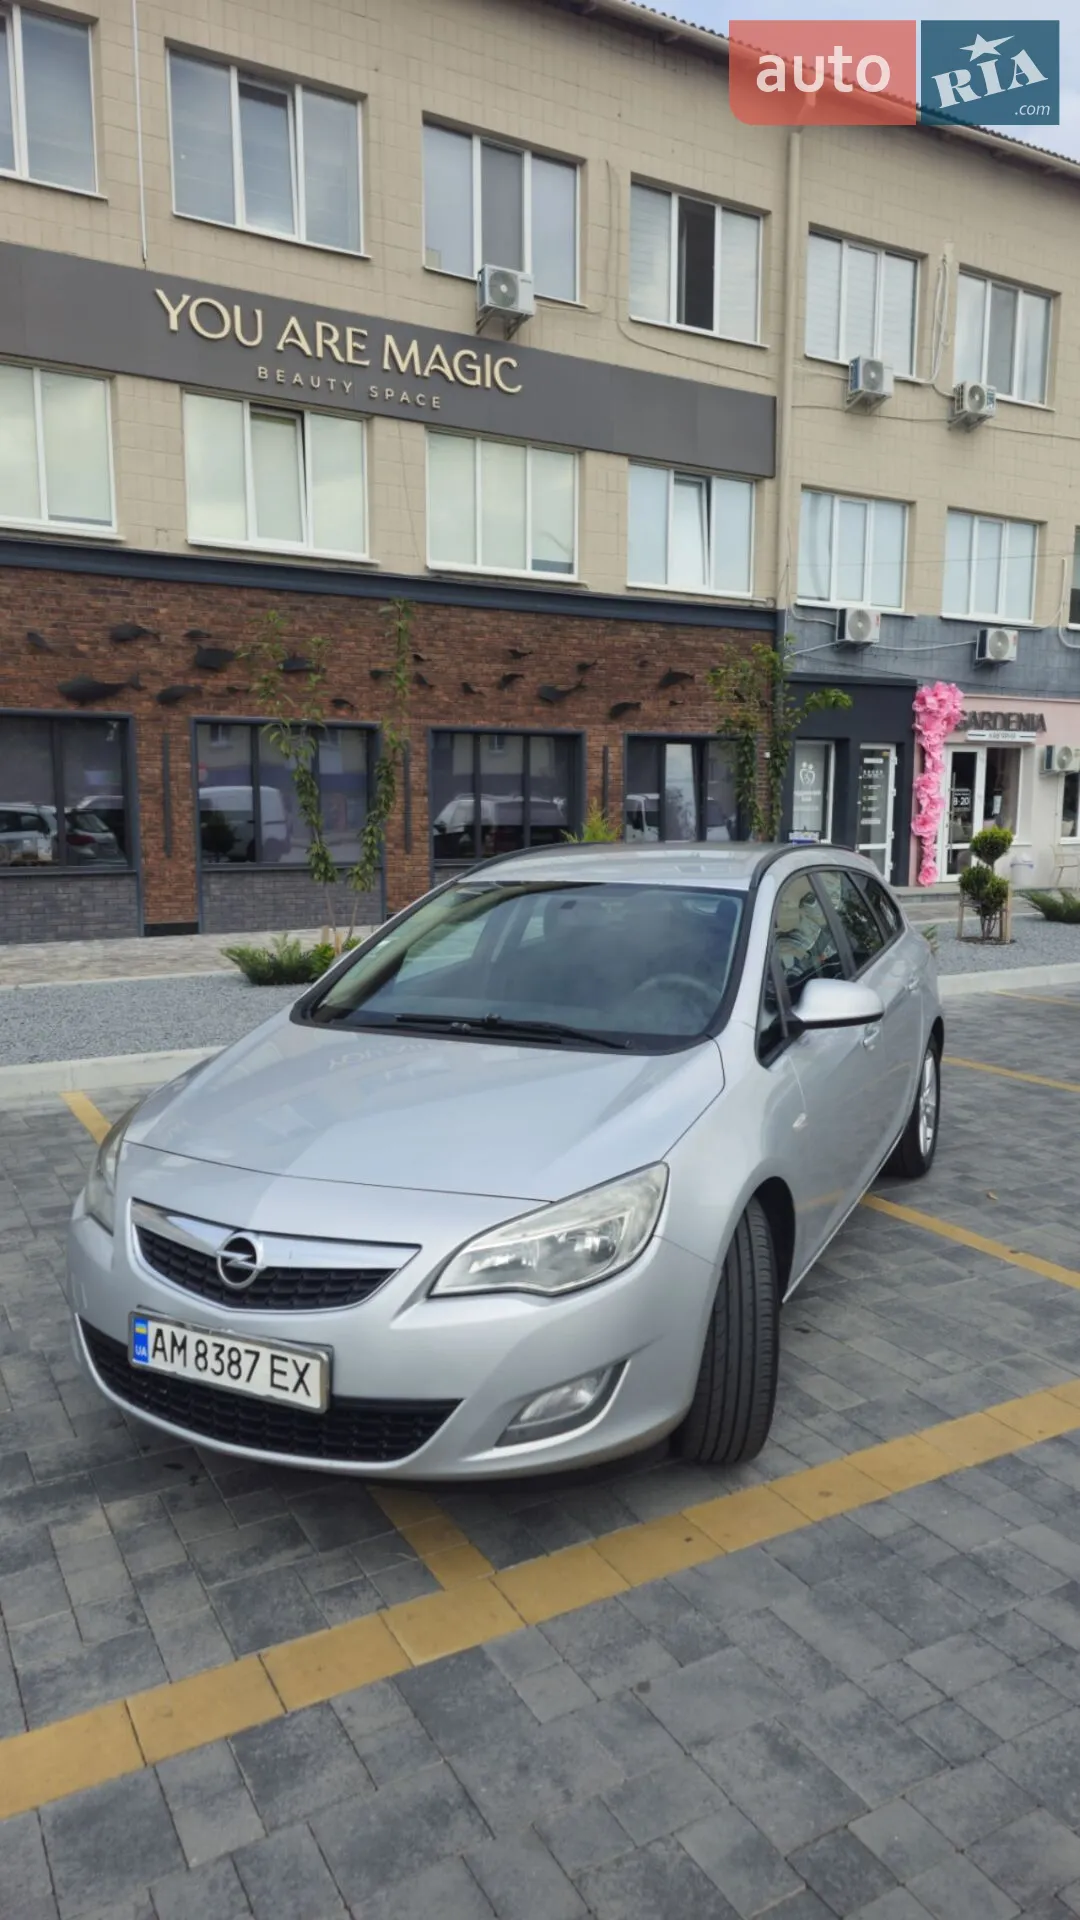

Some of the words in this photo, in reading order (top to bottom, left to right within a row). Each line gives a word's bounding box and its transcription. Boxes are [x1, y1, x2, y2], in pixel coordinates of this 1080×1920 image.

[155, 288, 263, 347] YOU
[276, 316, 371, 367] ARE
[382, 334, 523, 394] MAGIC
[257, 366, 353, 393] BEAUTY
[369, 385, 442, 409] SPACE
[134, 1344, 148, 1357] UA
[151, 1328, 188, 1368] AM
[194, 1339, 261, 1383] 8387
[269, 1354, 311, 1397] EX
